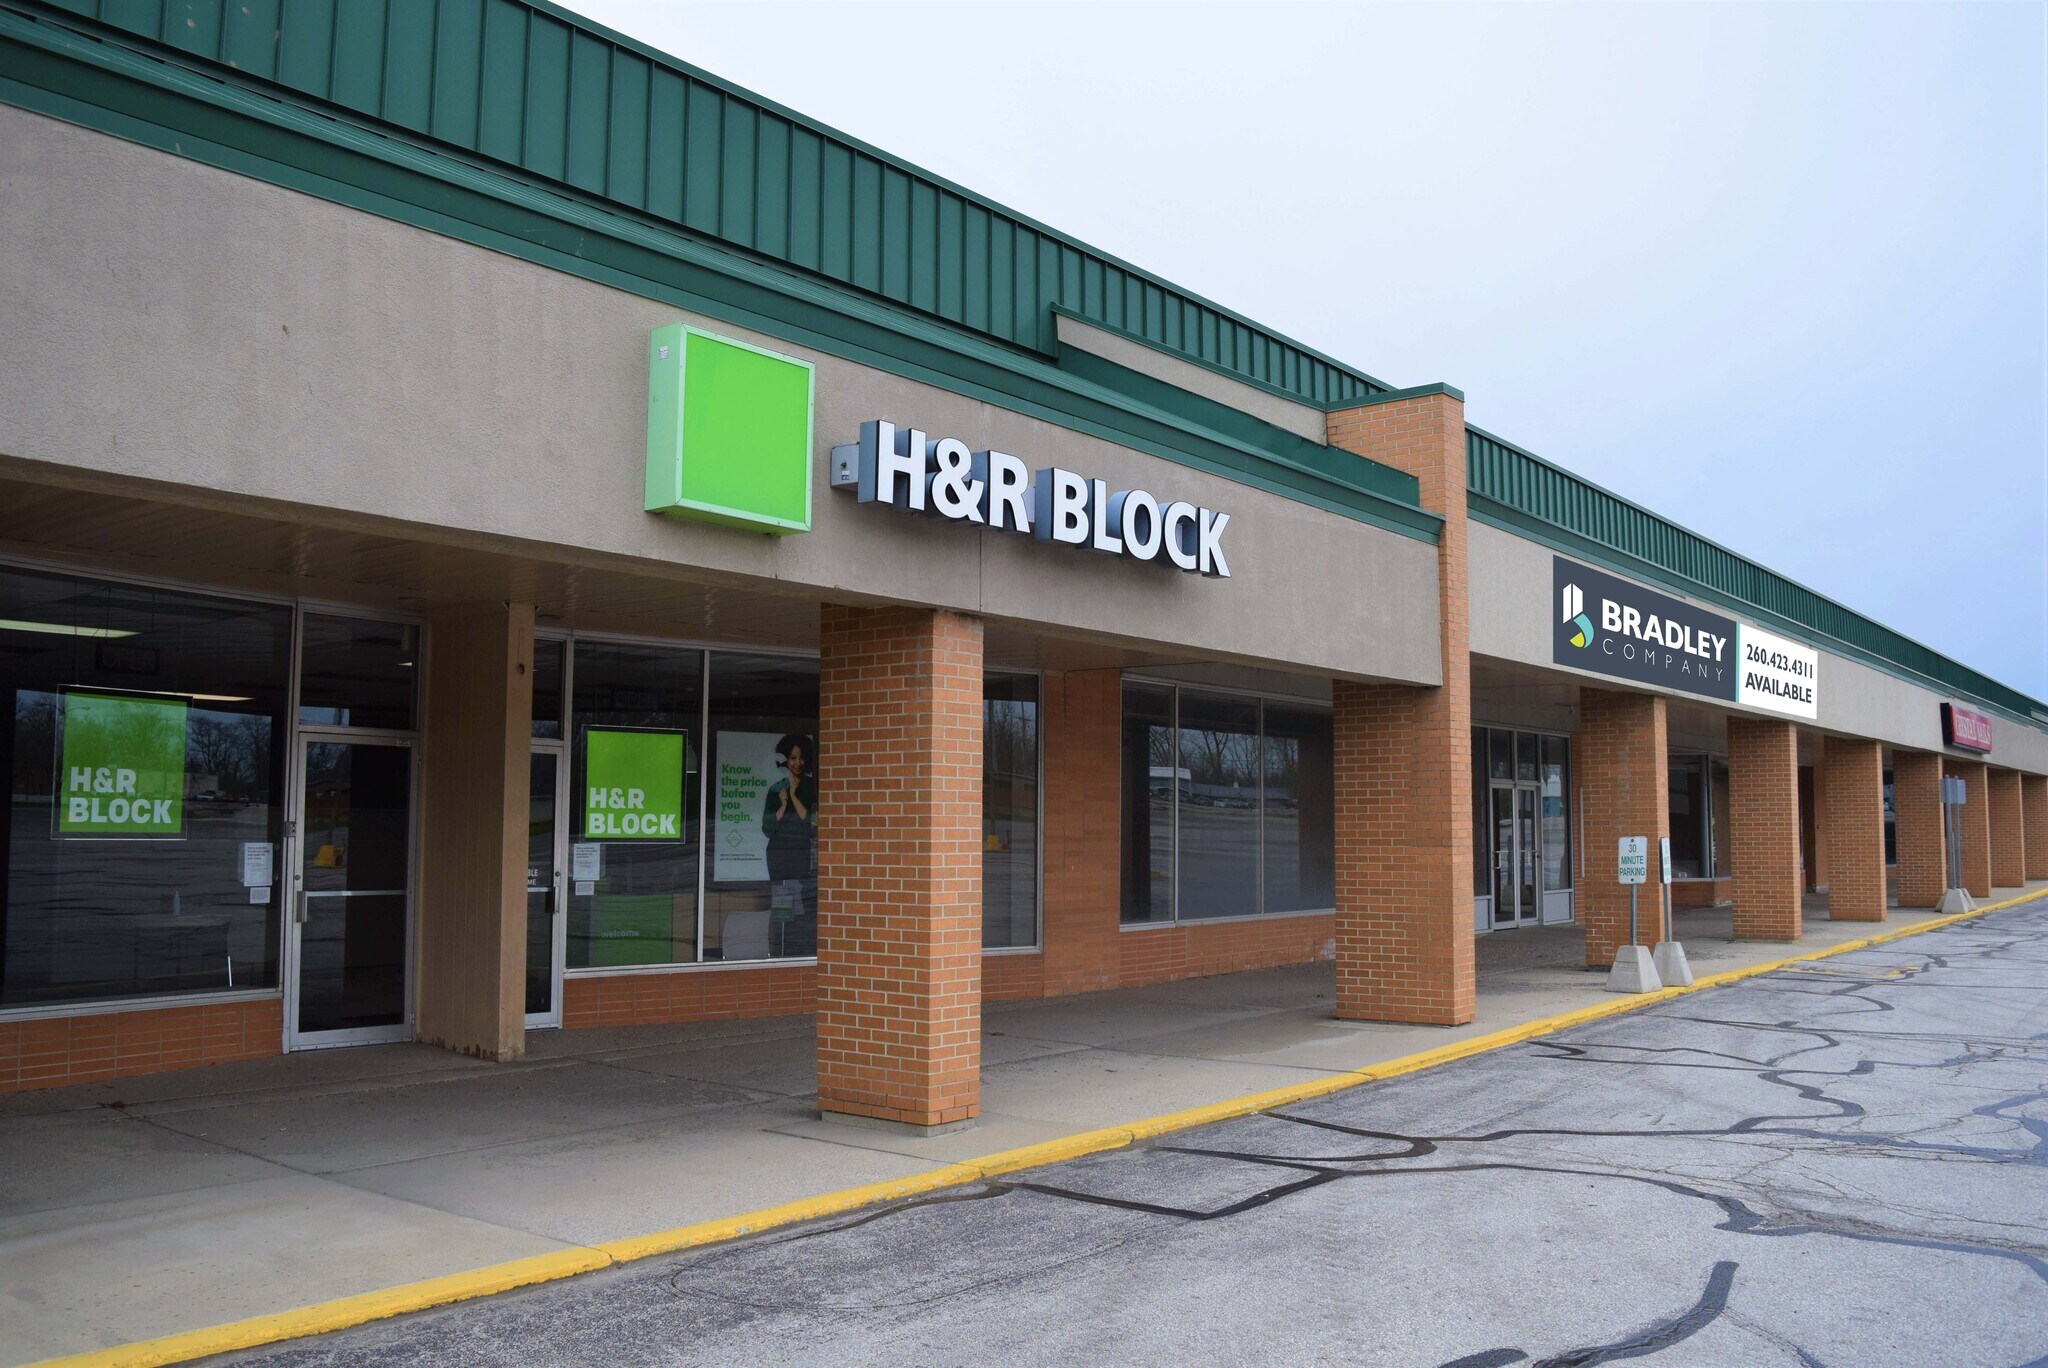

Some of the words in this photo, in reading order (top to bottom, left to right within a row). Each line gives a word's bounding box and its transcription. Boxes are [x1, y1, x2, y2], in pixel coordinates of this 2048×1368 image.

[877, 419, 1031, 533] H&R
[1053, 467, 1231, 578] BLOCK
[1602, 598, 1727, 662] BRADLEY
[102, 648, 155, 672] OPEN
[1603, 638, 1723, 682] COMPANY
[1746, 643, 1813, 679] 260.423.4311
[1745, 672, 1812, 704] AVAILABLE
[70, 766, 137, 794] H&R
[721, 763, 752, 775] Know
[721, 776, 739, 787] the
[741, 777, 768, 788] price
[588, 787, 645, 810] H&R
[721, 788, 756, 799] before
[68, 797, 172, 824] BLOCK
[721, 801, 741, 811] you
[588, 813, 676, 835] BLOCK
[721, 811, 754, 824] begin.
[1628, 844, 1637, 853] 30
[1621, 855, 1644, 865] MINUTE
[1619, 867, 1646, 876] PARKING
[600, 929, 640, 938] welcome
